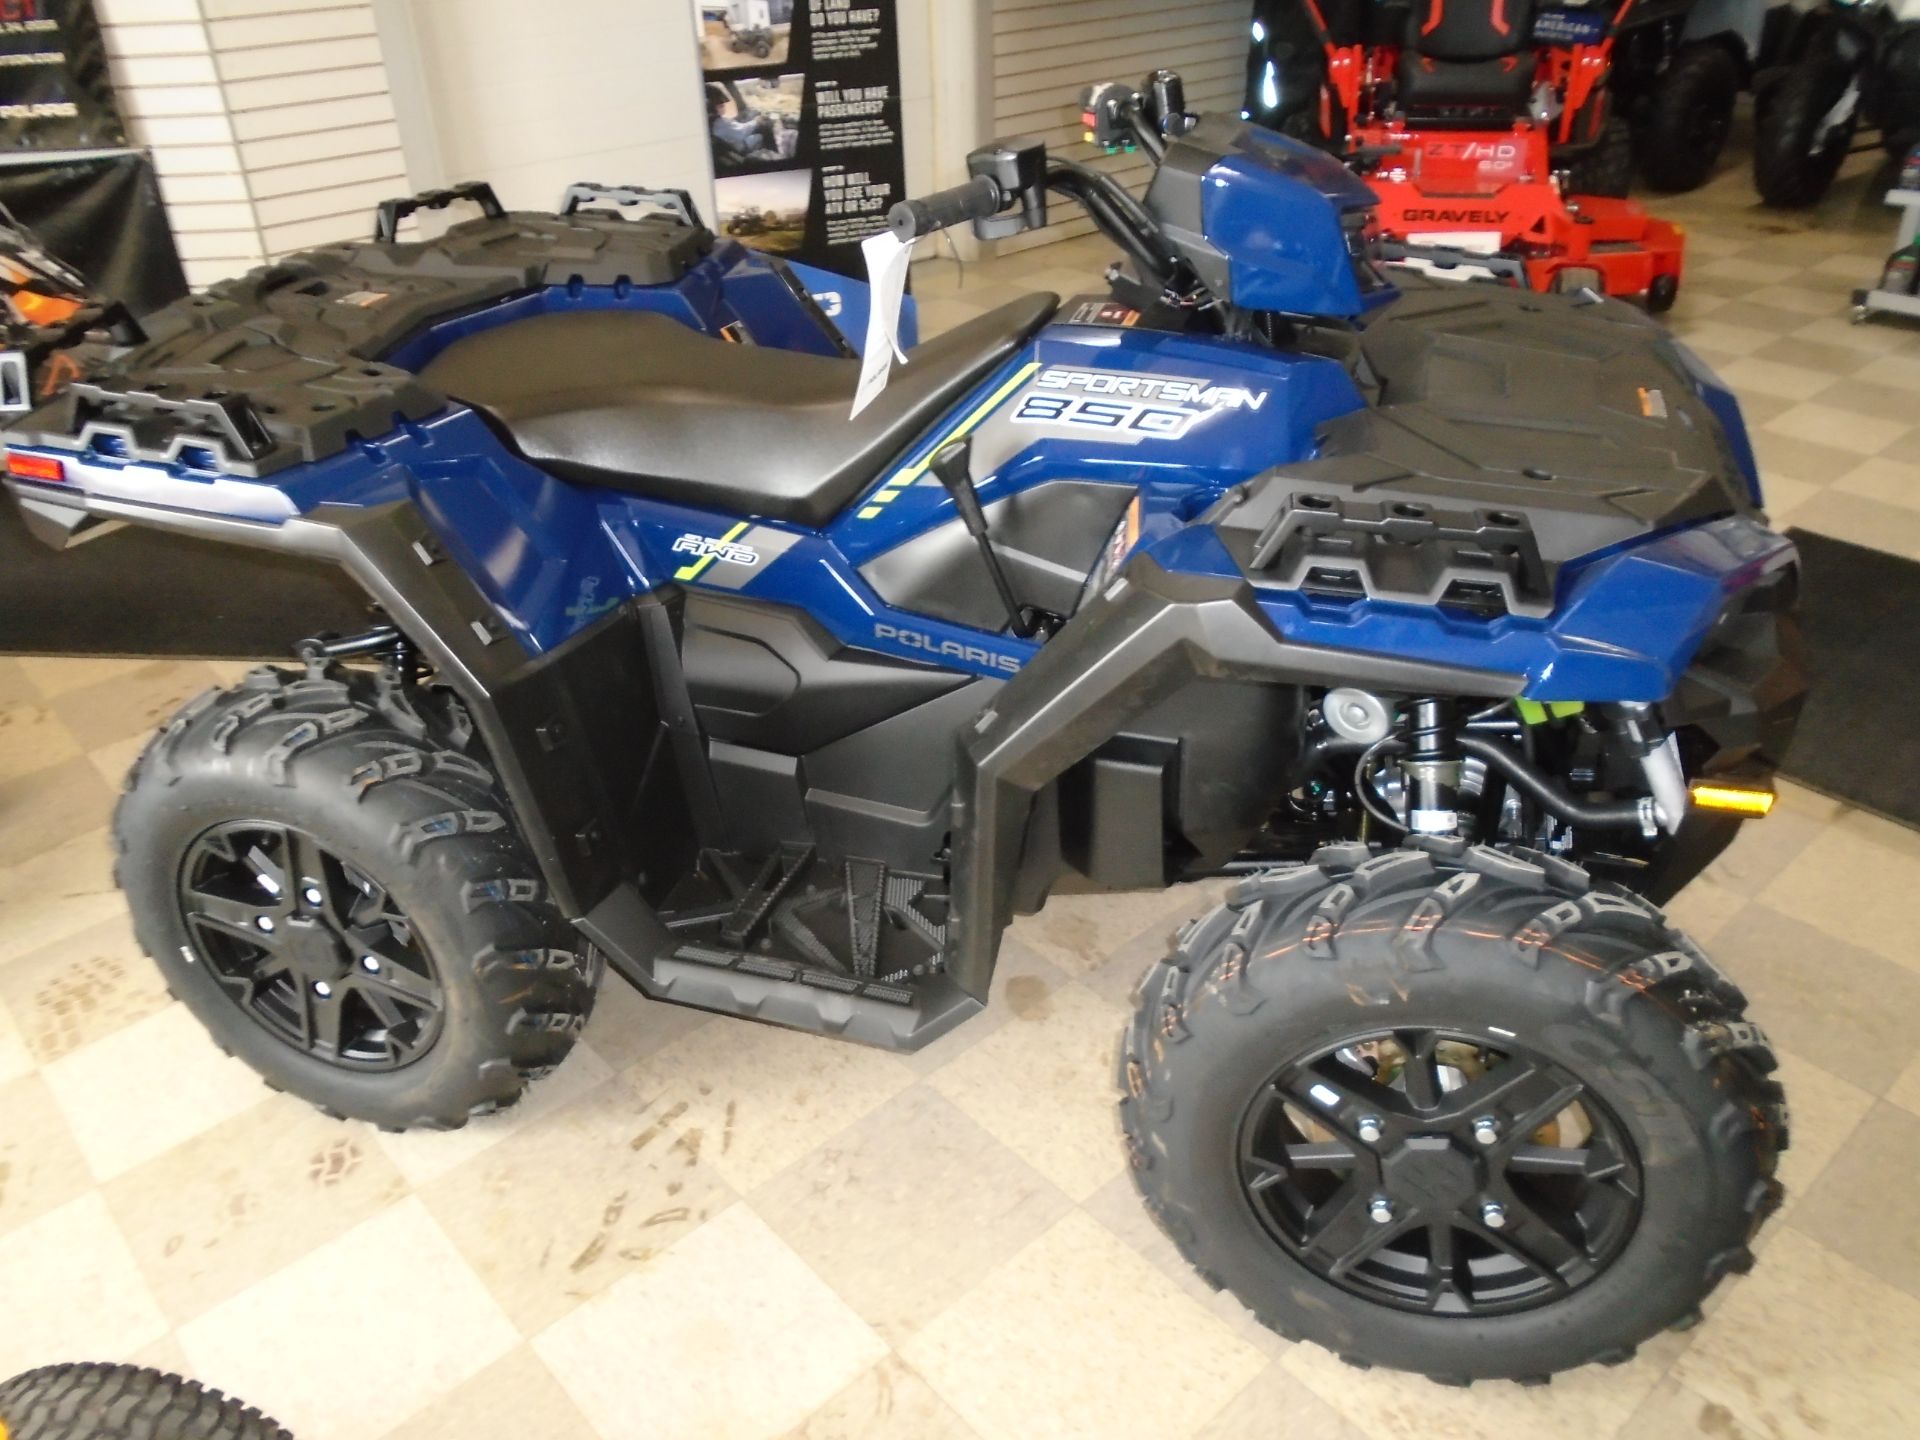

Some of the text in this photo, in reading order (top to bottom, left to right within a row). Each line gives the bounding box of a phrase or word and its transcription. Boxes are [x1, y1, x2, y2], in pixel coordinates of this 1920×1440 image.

[817, 101, 883, 118] PASSENGERS?
[1402, 208, 1511, 224] GRAVELY
[1037, 369, 1268, 411] SPORTSMAN
[1011, 392, 1199, 440] 850
[674, 538, 760, 565] AWD
[874, 623, 1022, 673] POLARIS
